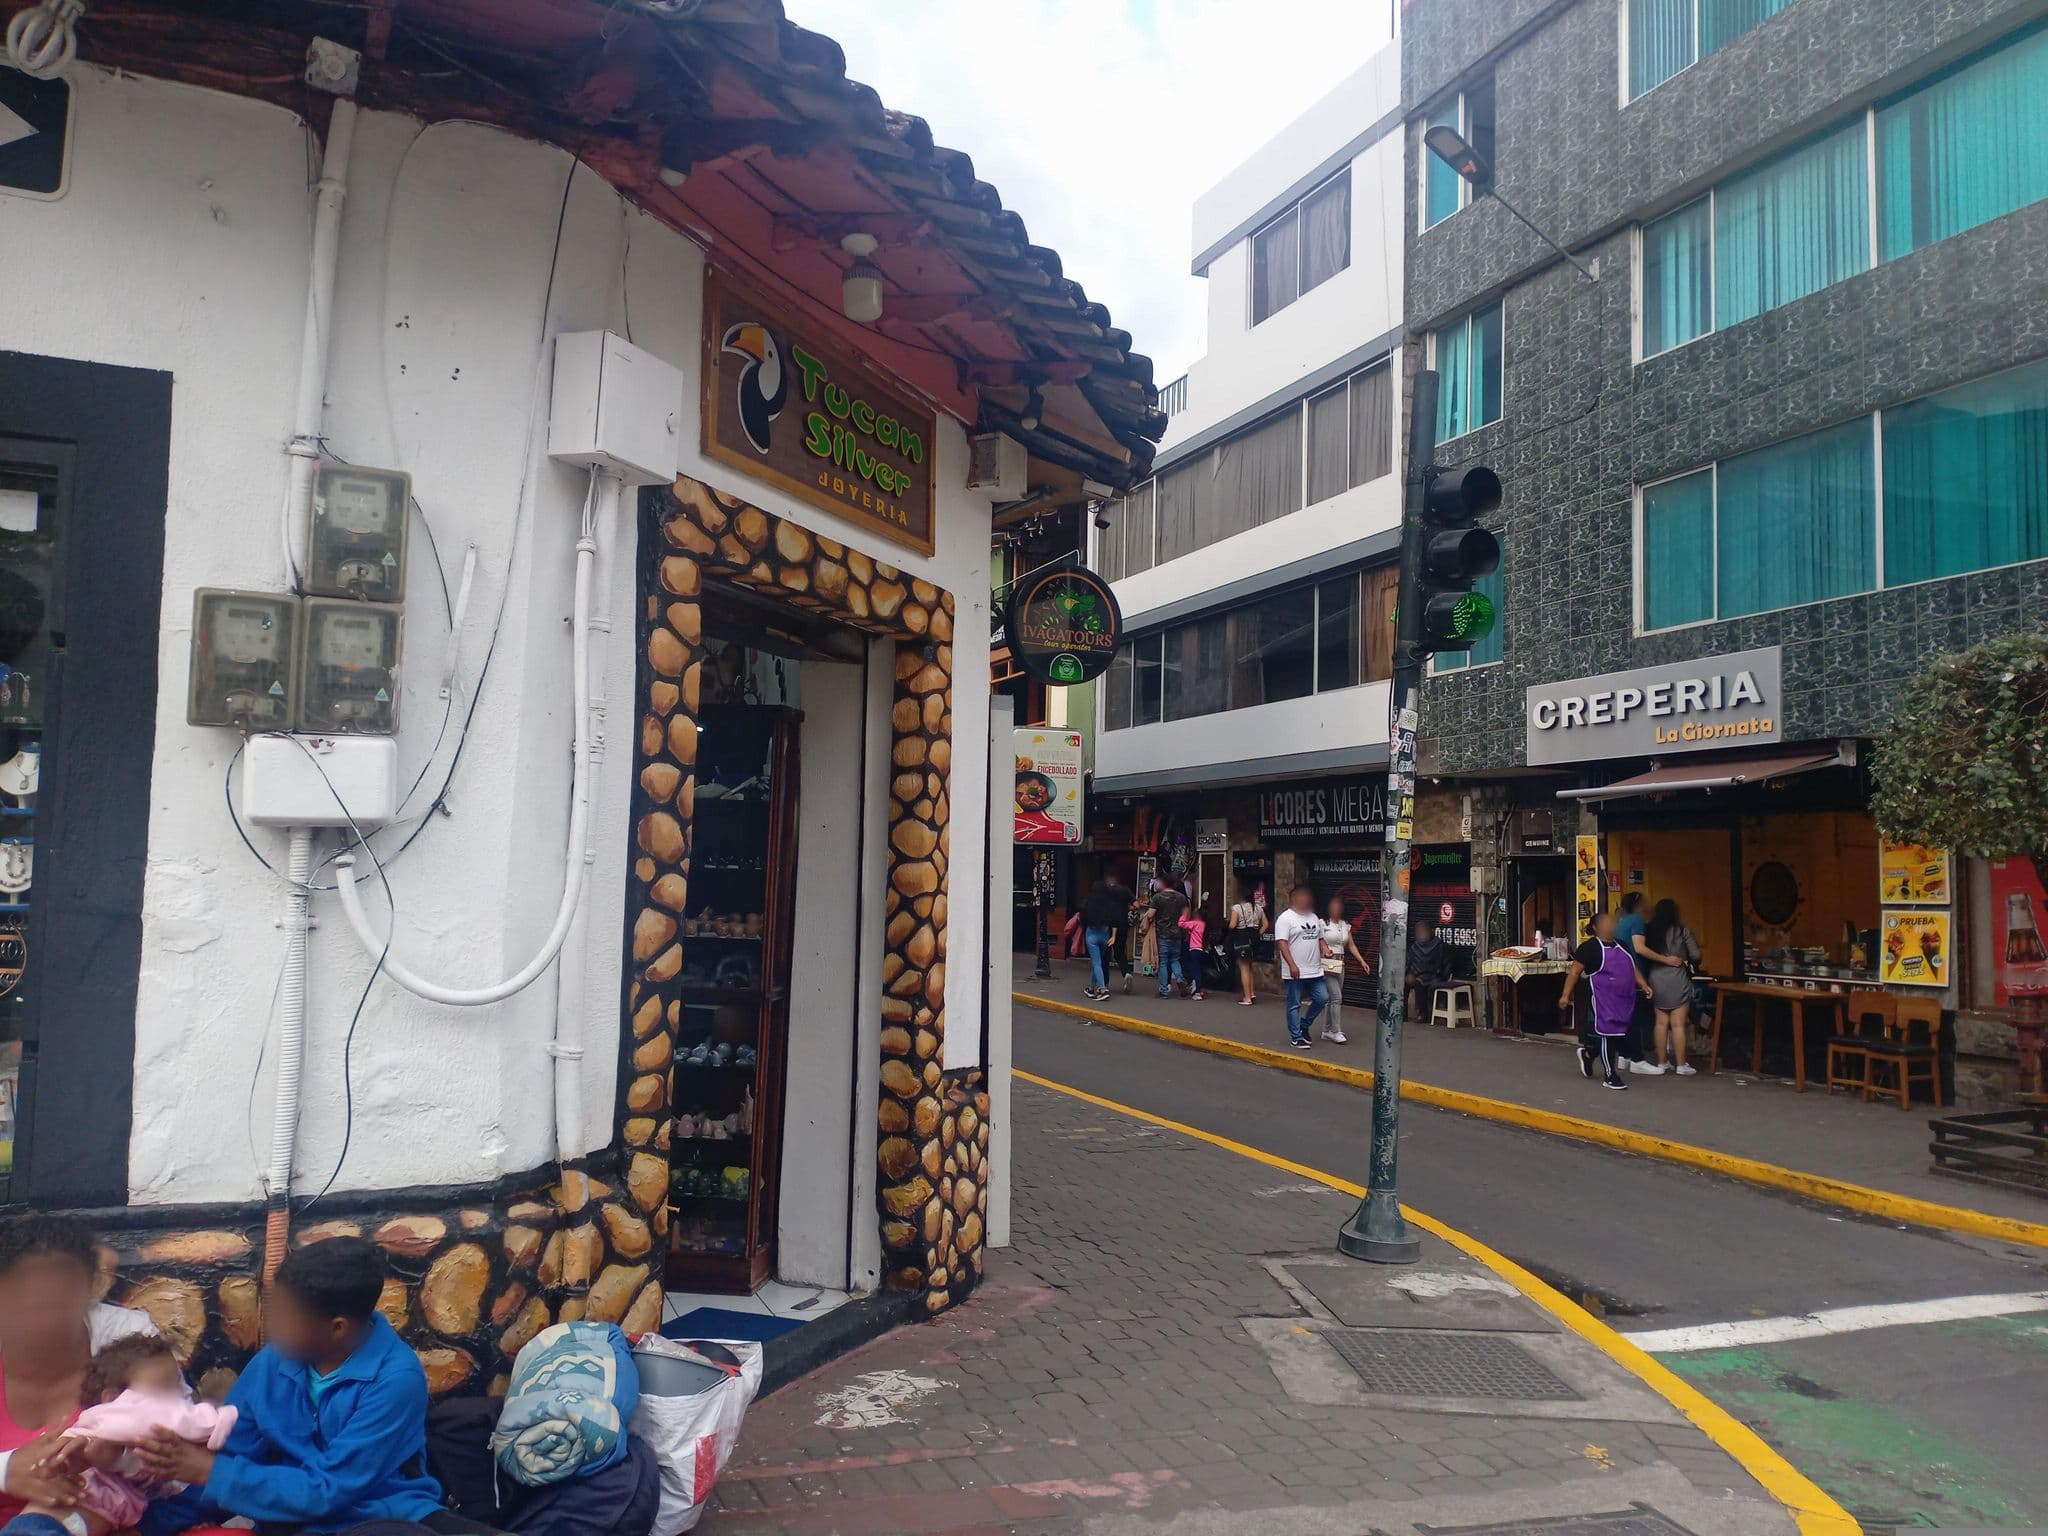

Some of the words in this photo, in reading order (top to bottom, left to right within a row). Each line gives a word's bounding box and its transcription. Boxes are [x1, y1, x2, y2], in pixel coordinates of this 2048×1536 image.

[793, 344, 923, 464] Tucan
[806, 412, 911, 497] Silver
[819, 472, 908, 526] JOYERIA
[1023, 623, 1113, 648] IVAGATOURS
[1533, 671, 1764, 731] CREPERIA
[1656, 726, 1680, 744] La
[1682, 717, 1774, 741] Giornata
[1037, 765, 1077, 775] ENCEBOLLADO
[1260, 790, 1327, 826] LICORES
[1333, 784, 1384, 823] MEGA
[1369, 824, 1384, 832] MENOR
[1900, 917, 1935, 926] PRUEBA
[1454, 928, 1477, 946] 5963
